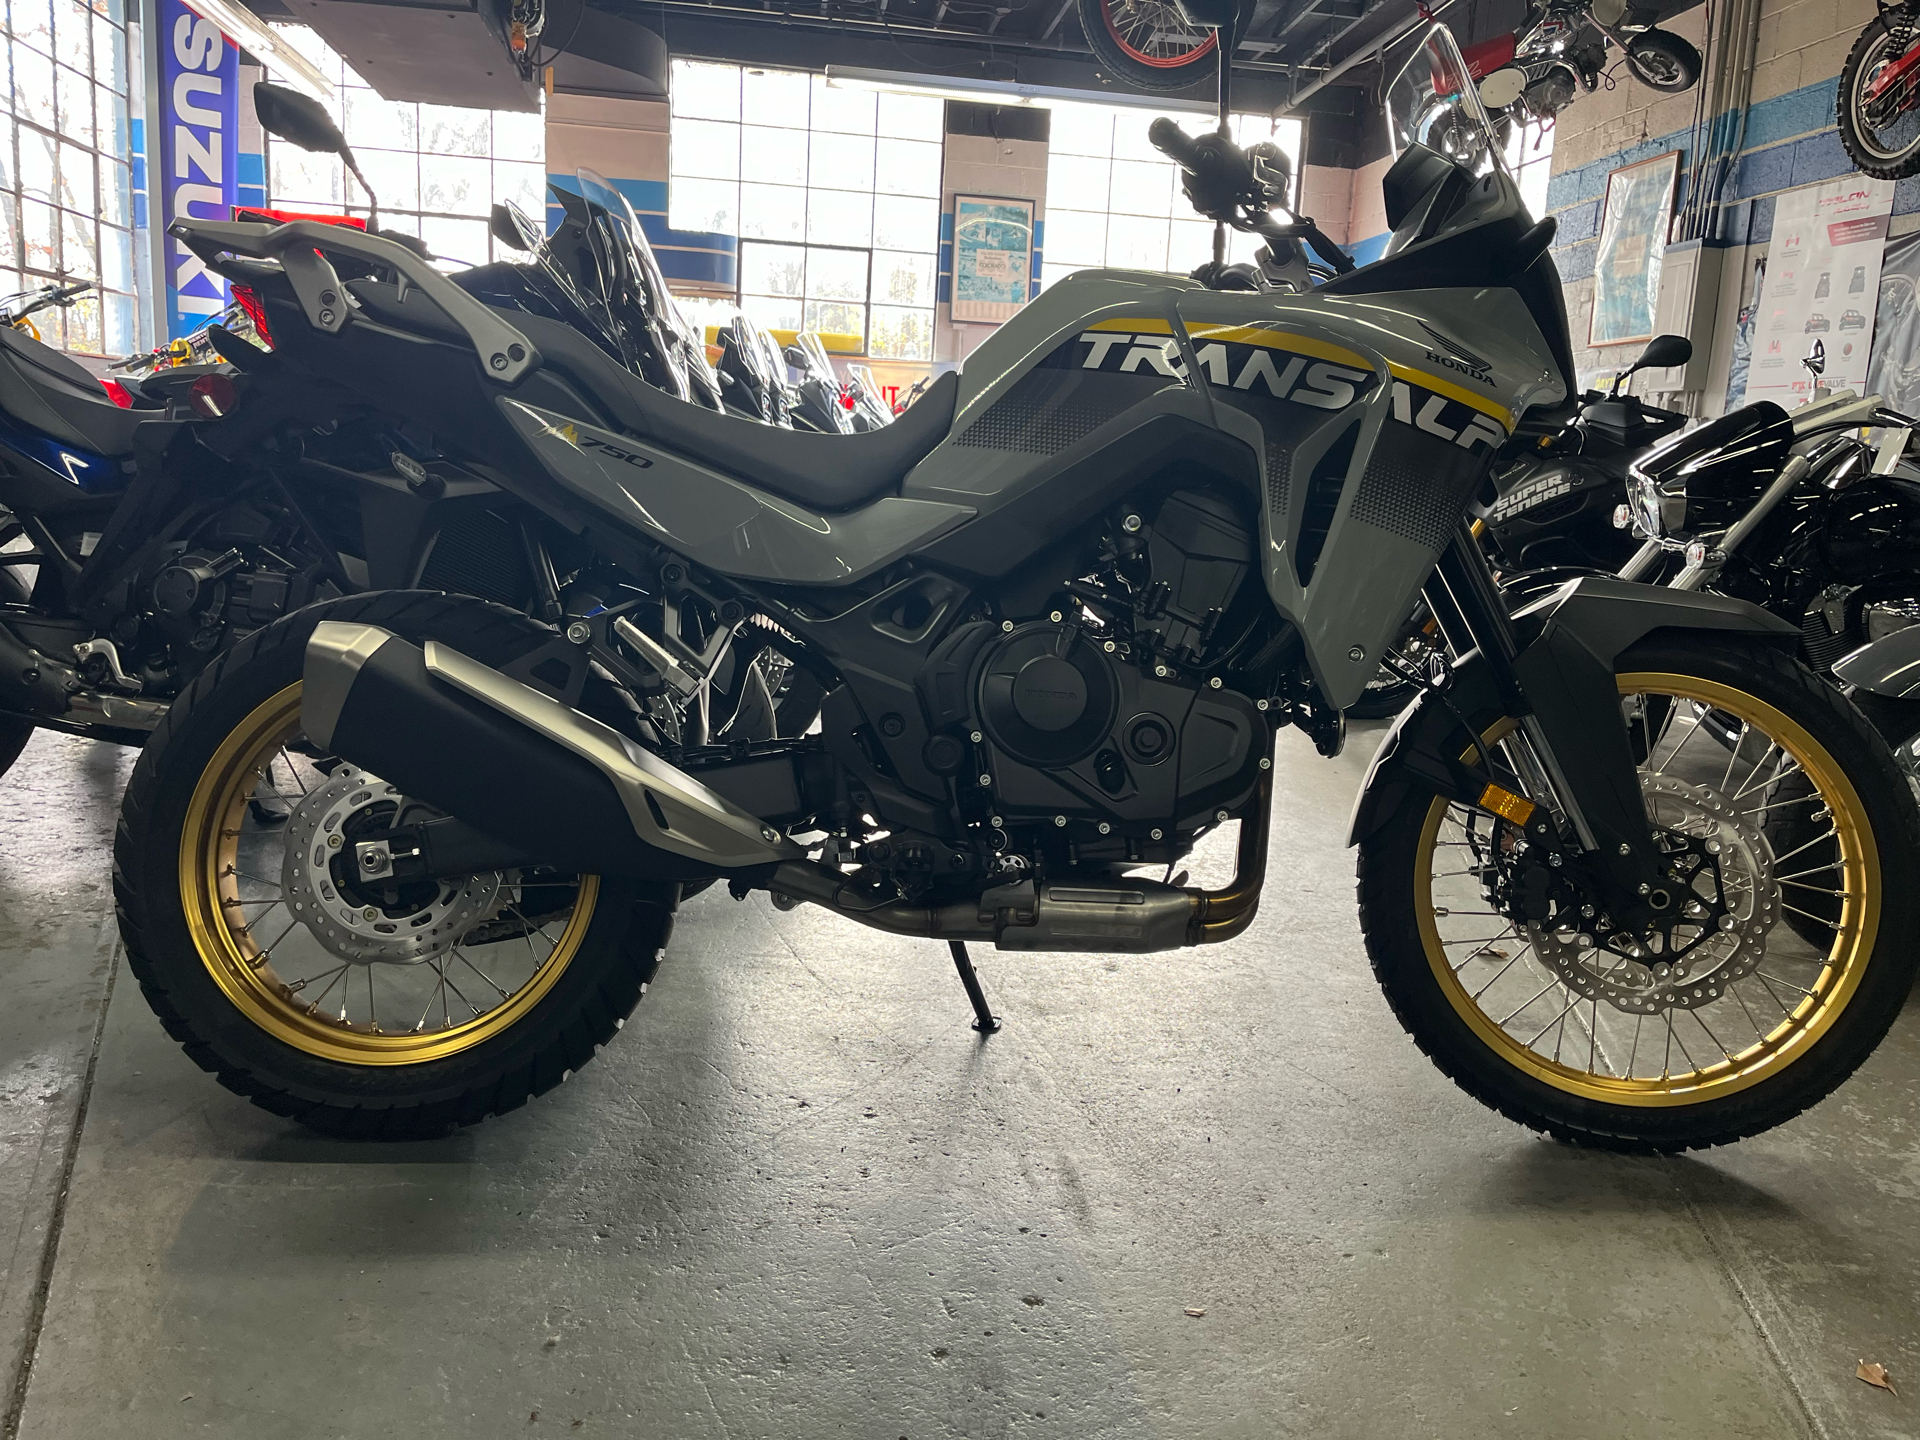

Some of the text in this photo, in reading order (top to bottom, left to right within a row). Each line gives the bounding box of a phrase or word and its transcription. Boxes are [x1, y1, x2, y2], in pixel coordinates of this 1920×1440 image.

[173, 14, 225, 317] SUZUKI
[1425, 350, 1498, 388] HONDA
[1079, 332, 1504, 450] TRANSALP
[581, 436, 654, 469] 750
[1493, 482, 1571, 522] TENERE
[1497, 474, 1563, 512] SUPER
